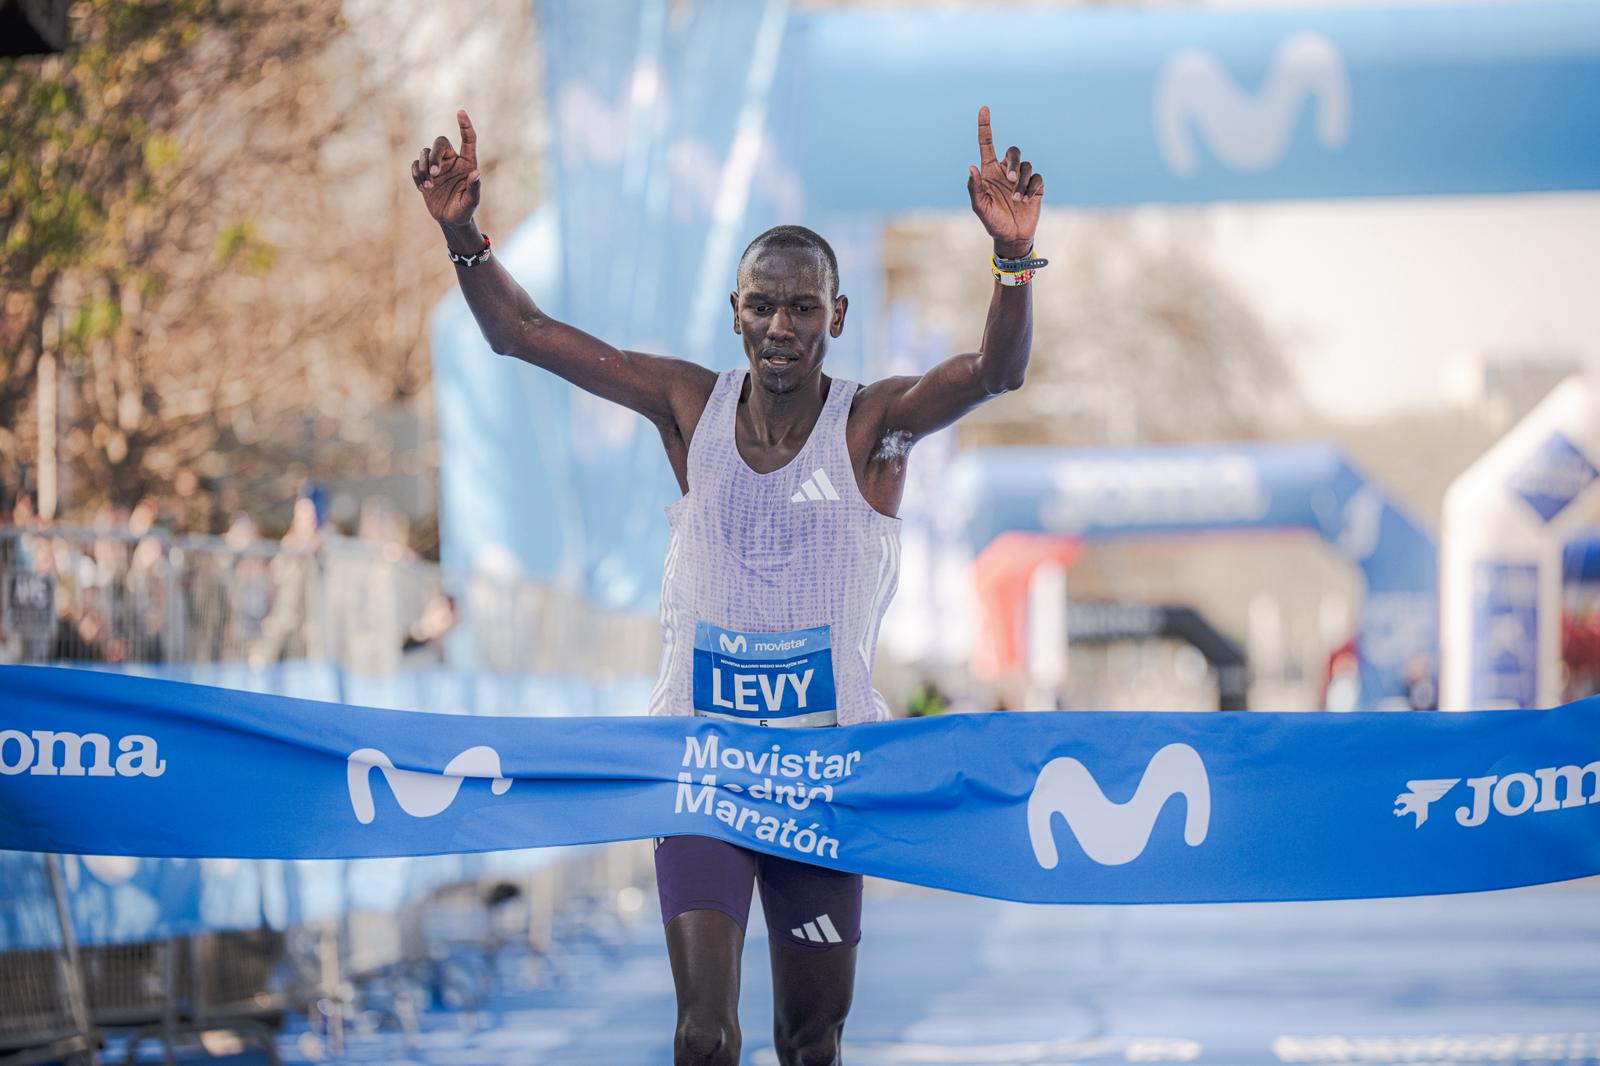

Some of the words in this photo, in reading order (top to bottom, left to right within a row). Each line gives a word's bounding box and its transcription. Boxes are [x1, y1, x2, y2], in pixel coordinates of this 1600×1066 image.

[755, 637, 808, 652] movistar
[712, 668, 815, 712] LEVY
[681, 735, 861, 780] Movistar
[674, 782, 840, 859] Maratón
